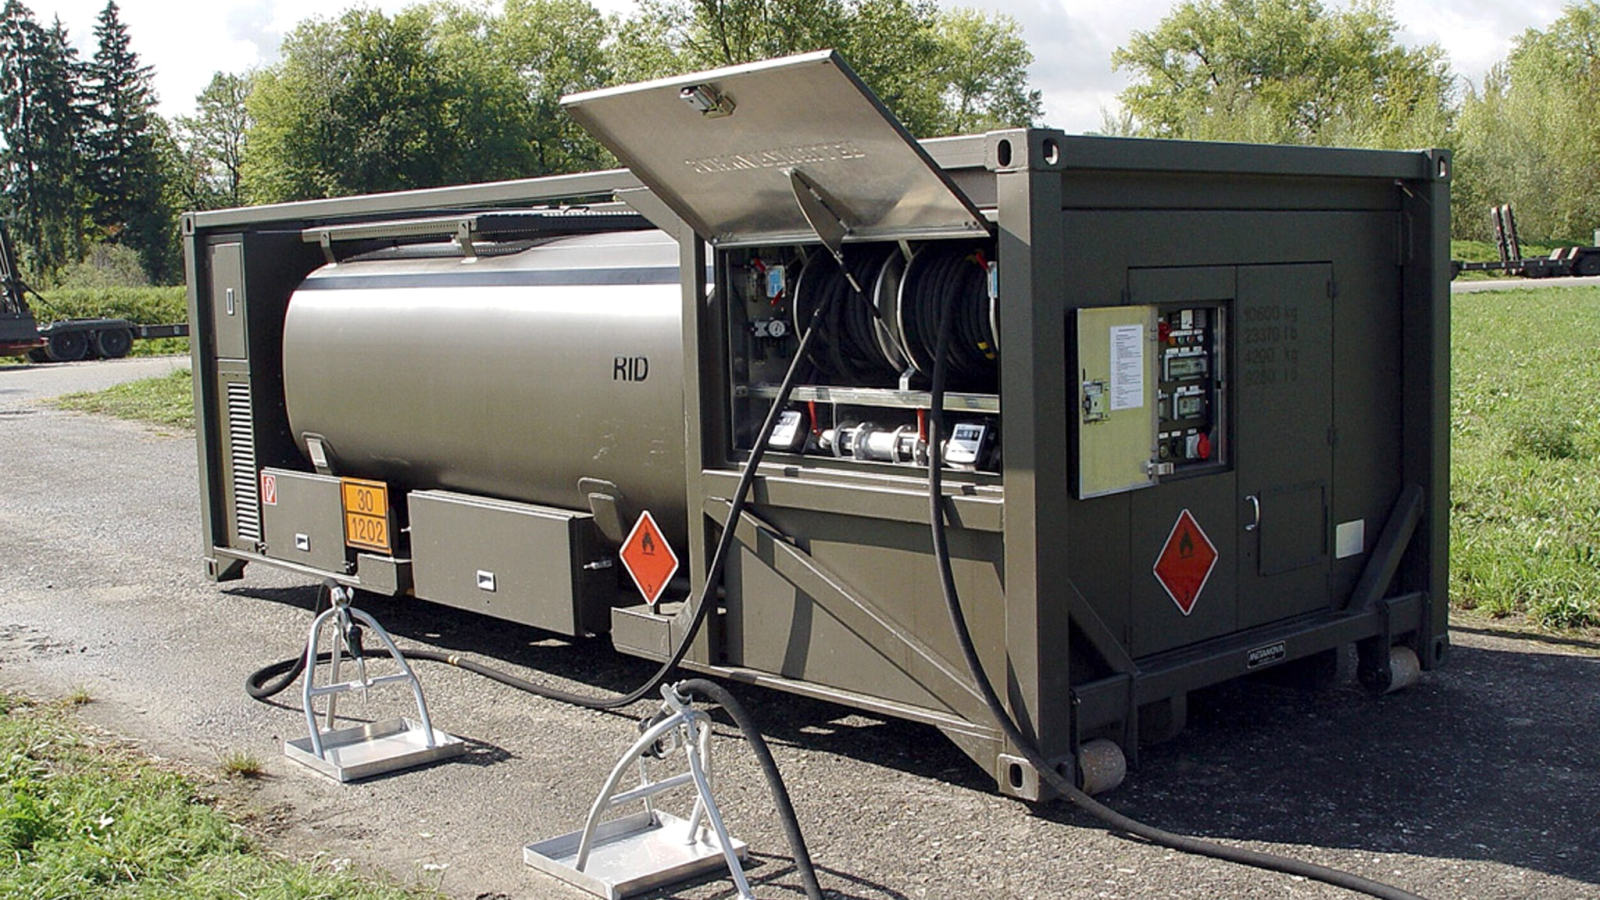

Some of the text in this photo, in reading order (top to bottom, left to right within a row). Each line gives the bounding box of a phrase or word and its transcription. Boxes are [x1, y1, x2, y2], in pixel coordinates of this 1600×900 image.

[1244, 305, 1298, 323] 10600 kg
[1244, 326, 1280, 344] 23370
[1244, 347, 1298, 364] 4200 kg
[613, 356, 649, 382] RID
[357, 488, 374, 512] 30
[351, 516, 384, 543] 1202
